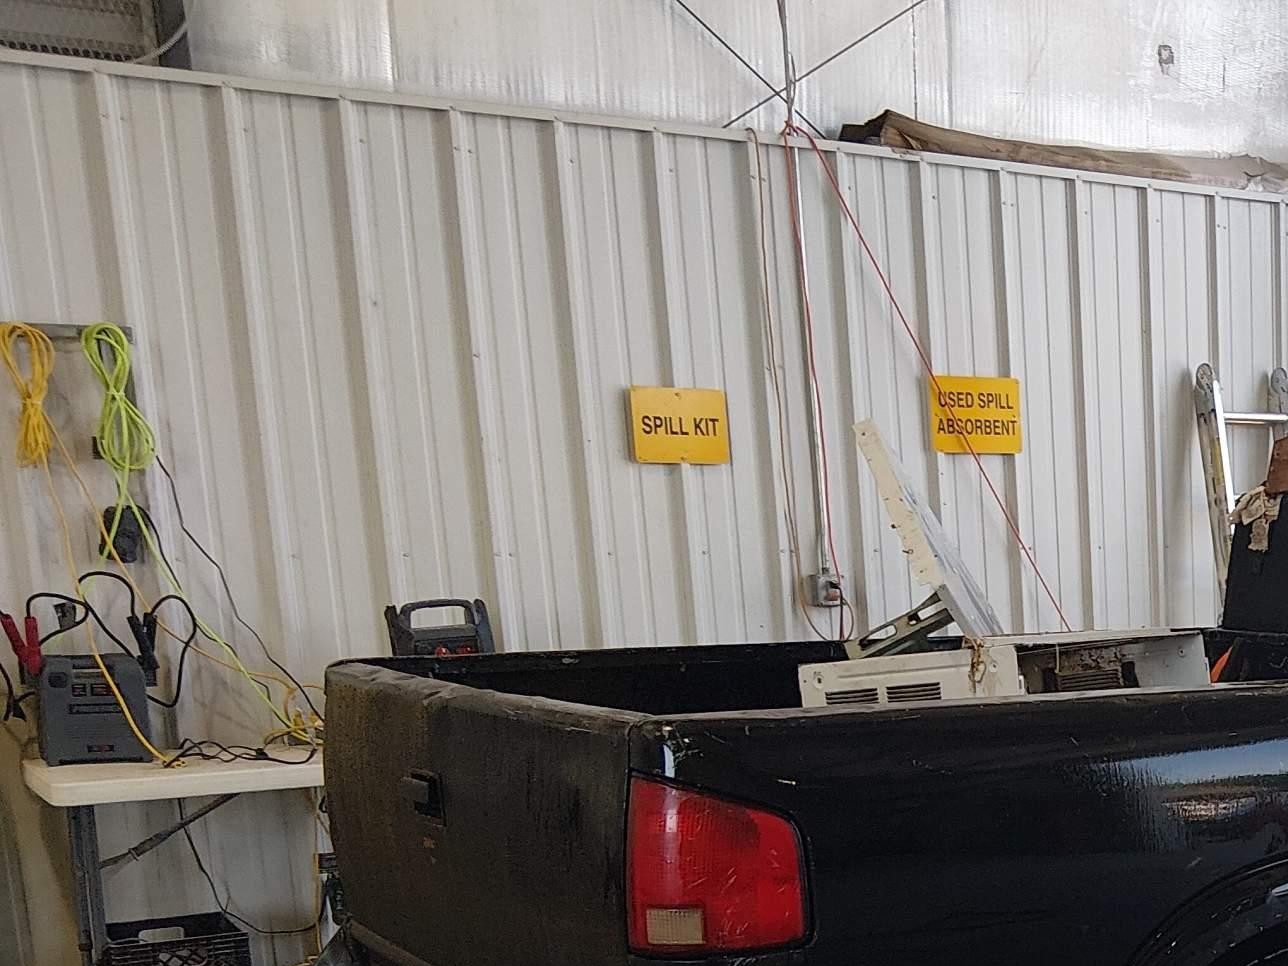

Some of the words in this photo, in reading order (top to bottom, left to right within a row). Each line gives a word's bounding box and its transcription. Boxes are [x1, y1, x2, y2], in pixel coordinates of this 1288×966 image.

[938, 391, 974, 408] USED
[977, 393, 1014, 409] SPILL
[641, 415, 689, 436] SPILL
[693, 417, 719, 436] KIT
[937, 418, 1017, 435] ABSORBENT
